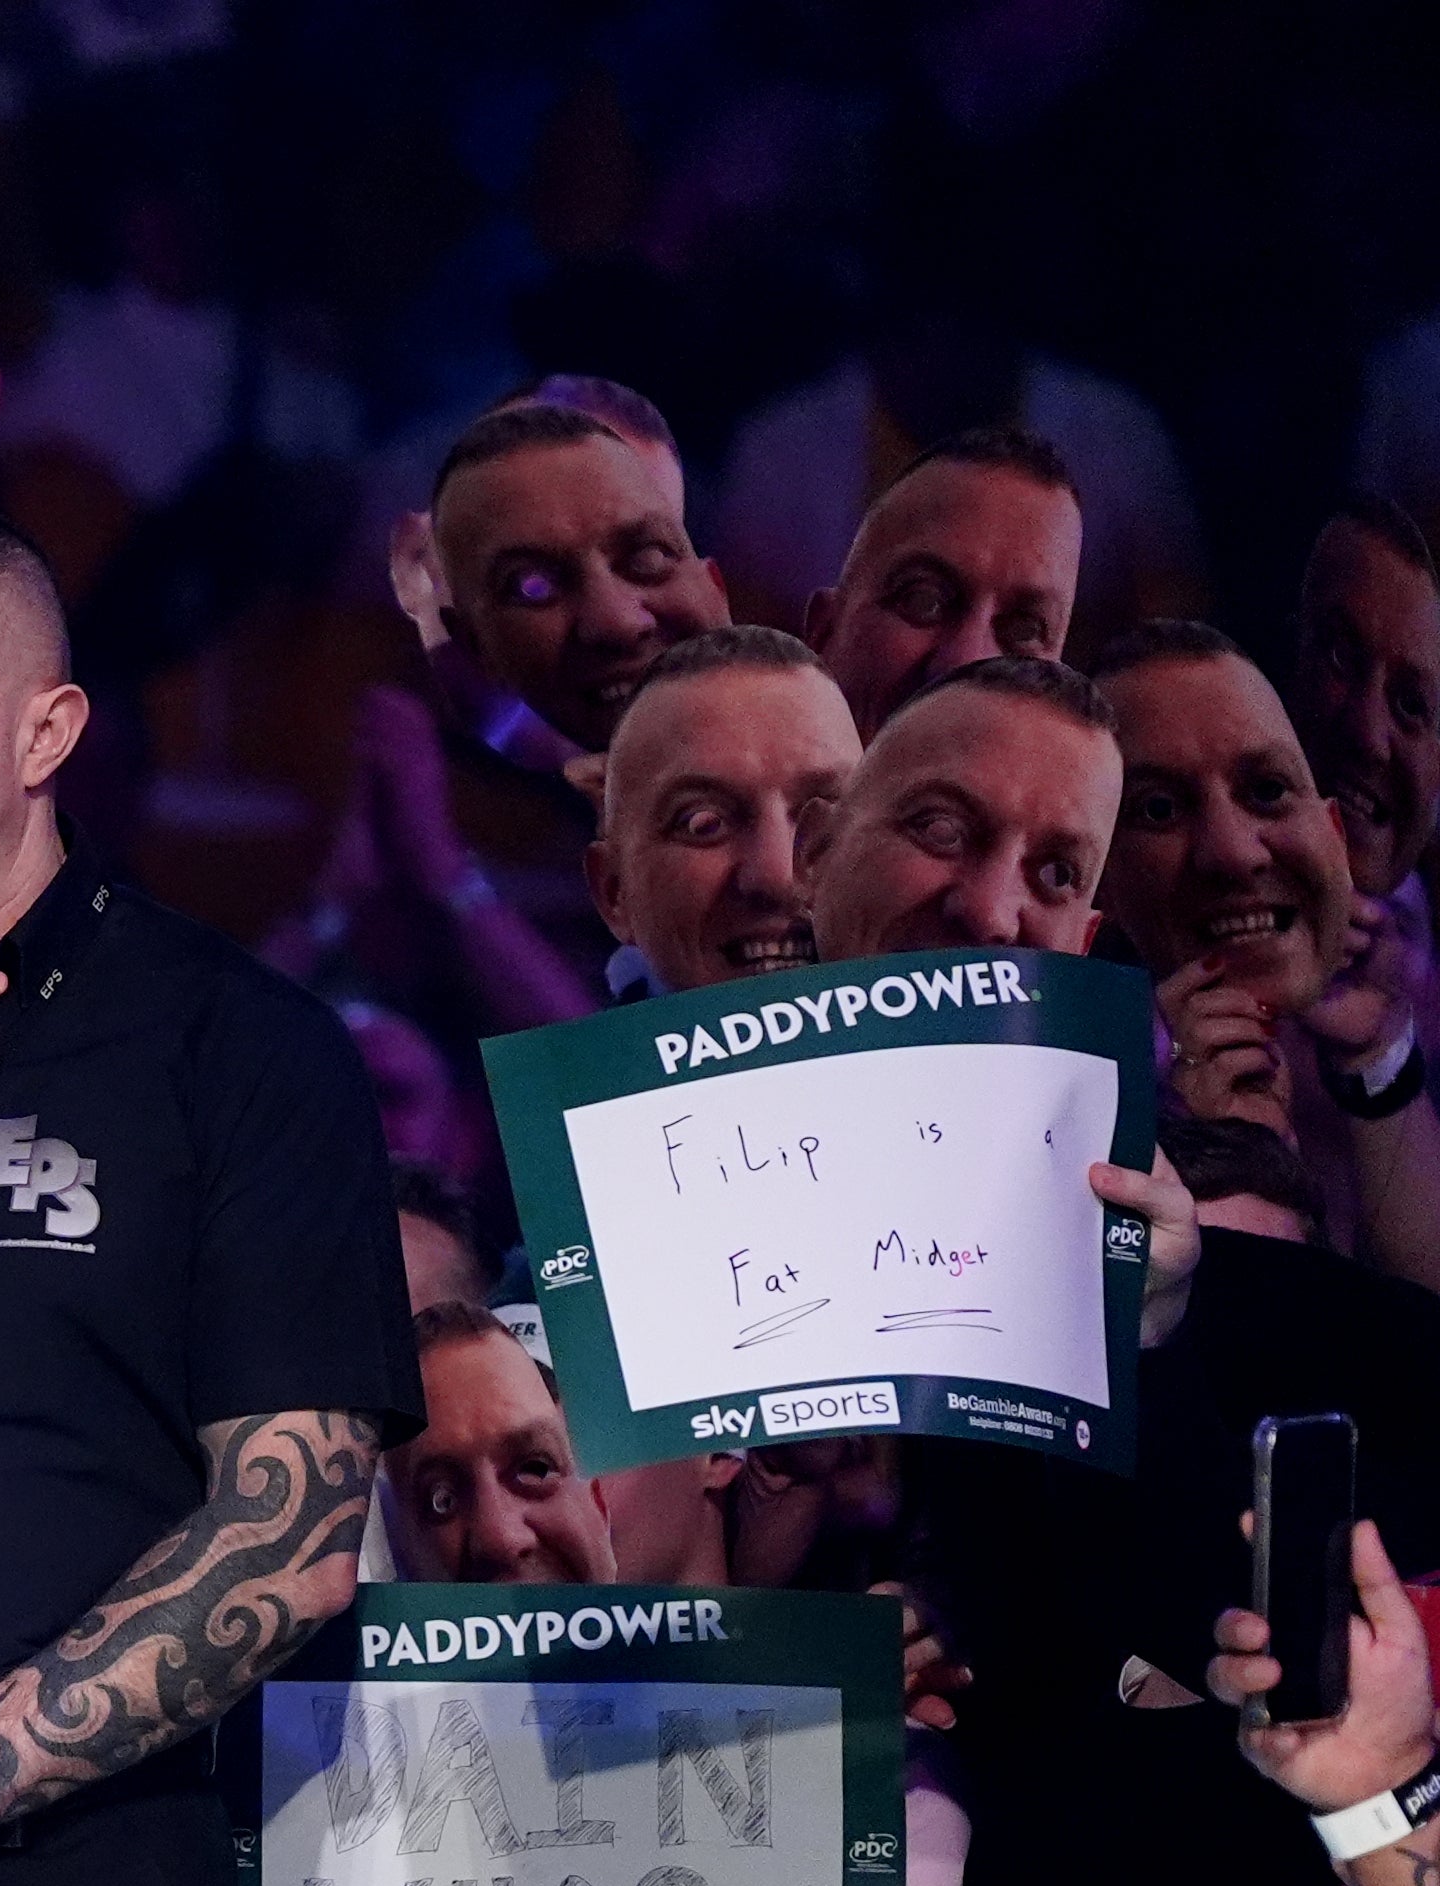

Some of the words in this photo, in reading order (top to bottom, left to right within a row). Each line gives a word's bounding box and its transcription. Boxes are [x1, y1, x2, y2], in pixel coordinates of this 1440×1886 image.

[92, 884, 111, 913] EPS
[40, 968, 64, 1000] EPS
[917, 1119, 944, 1145] is
[729, 1248, 802, 1307] Fat
[872, 1228, 990, 1277] Midget
[690, 1400, 757, 1441] sky
[768, 1387, 892, 1431] sports
